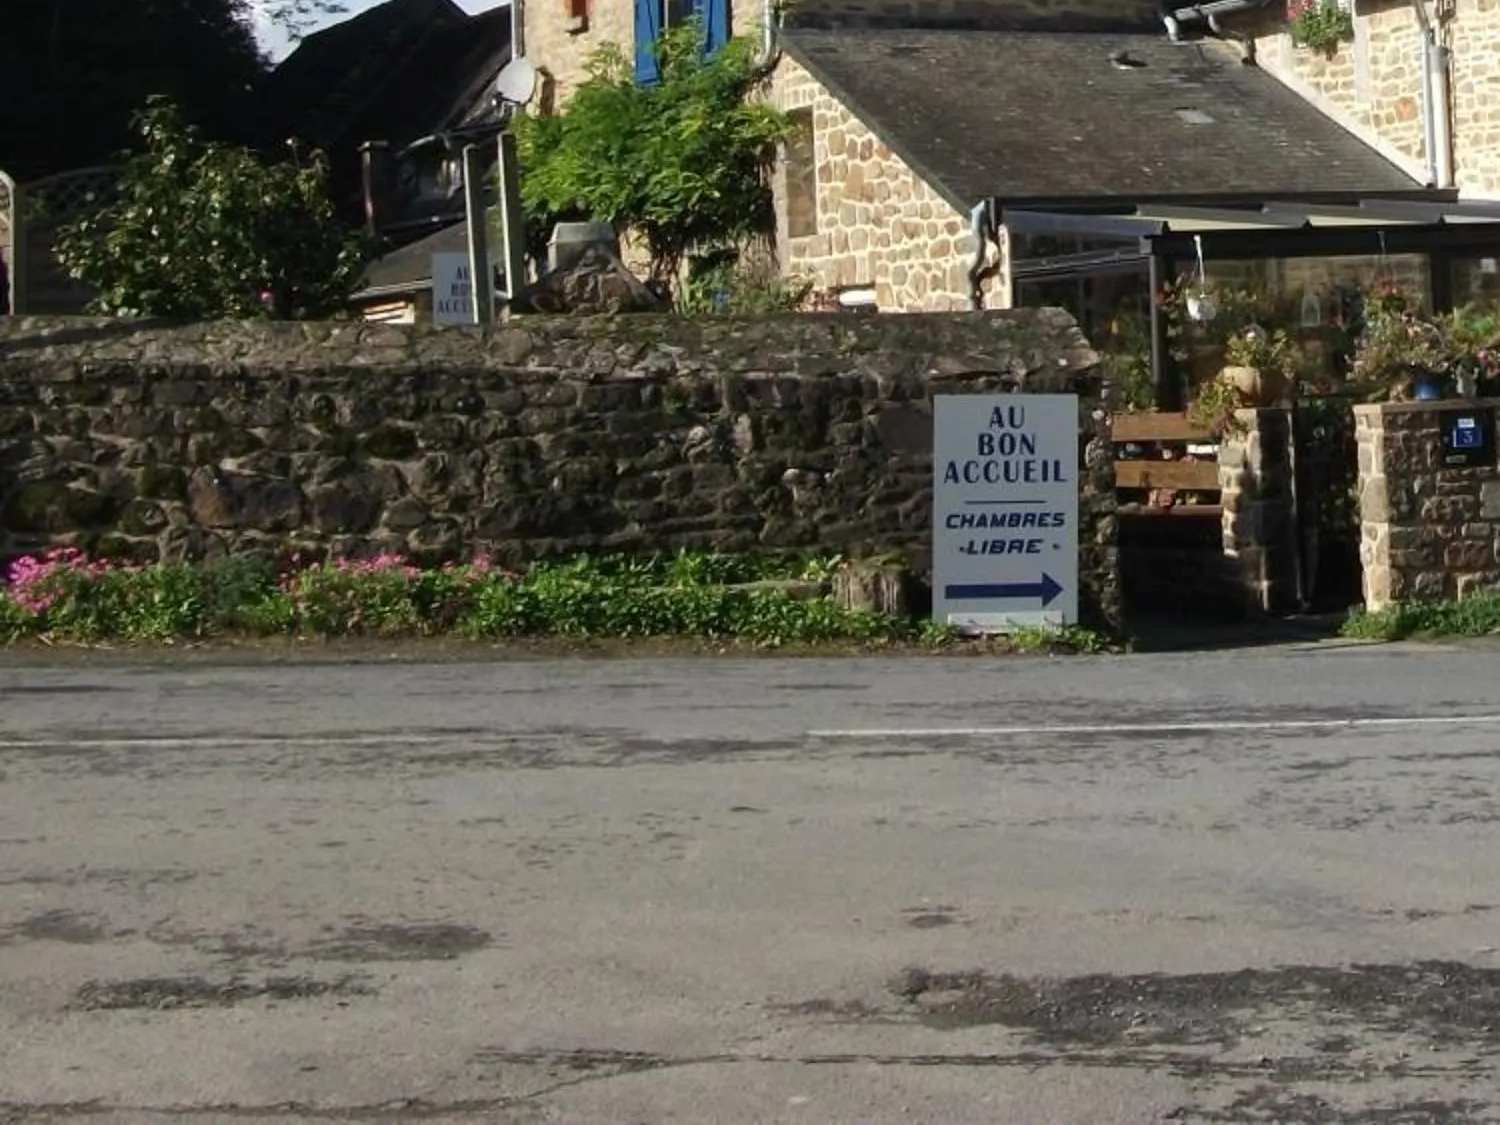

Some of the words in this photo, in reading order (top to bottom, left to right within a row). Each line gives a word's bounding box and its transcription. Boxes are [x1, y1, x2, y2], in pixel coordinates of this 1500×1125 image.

[989, 406, 1025, 429] AU
[977, 433, 1036, 456] BON
[944, 459, 1068, 484] ACCUEIL
[945, 512, 1066, 529] CHAMBRES
